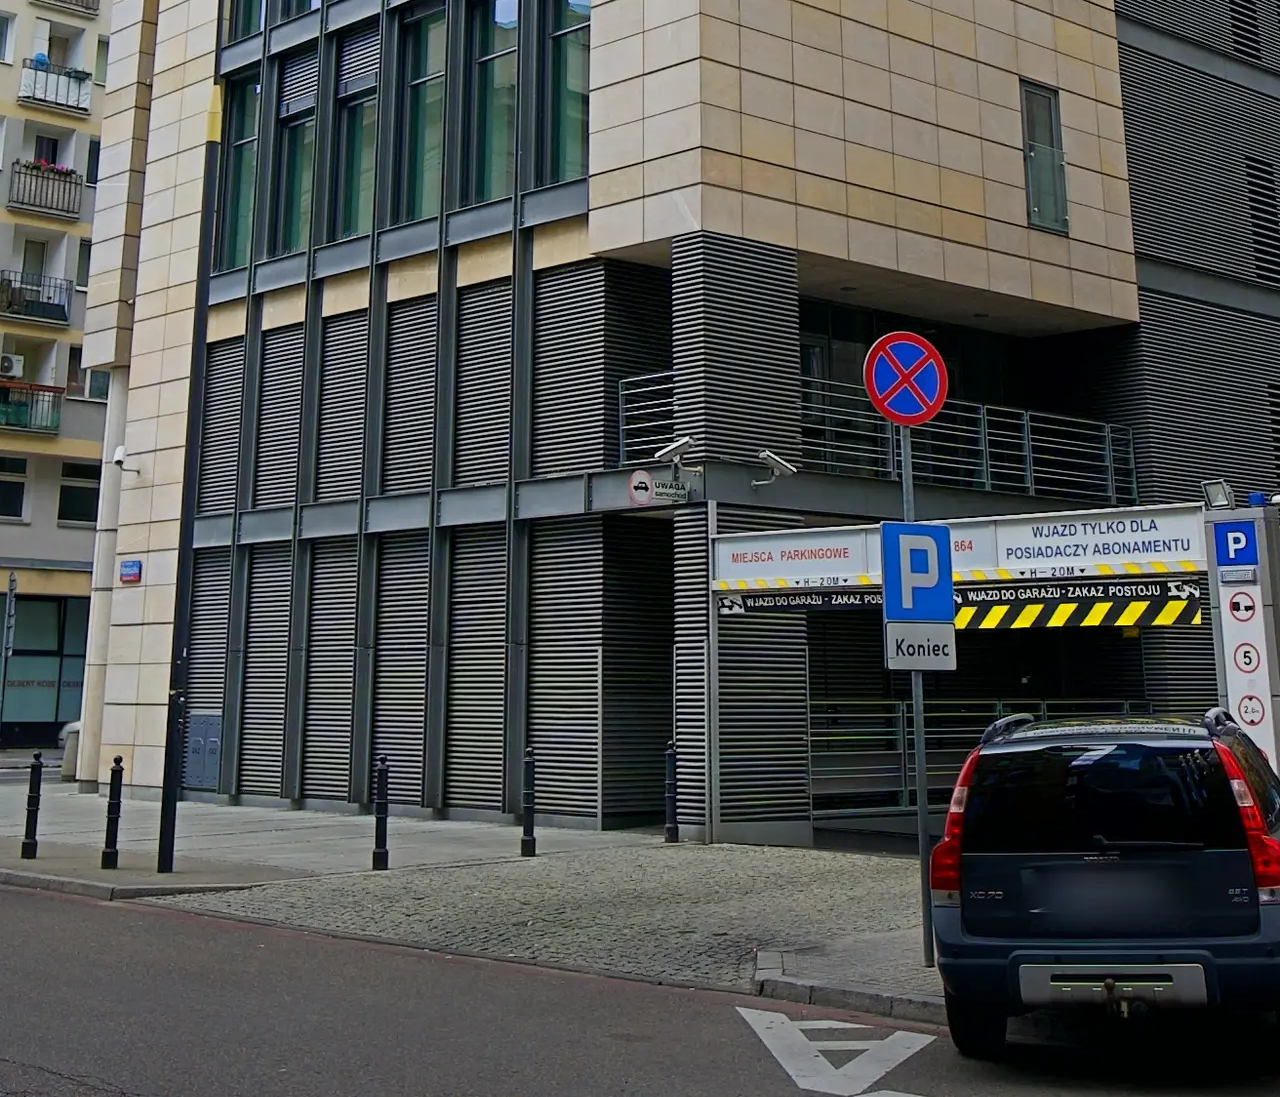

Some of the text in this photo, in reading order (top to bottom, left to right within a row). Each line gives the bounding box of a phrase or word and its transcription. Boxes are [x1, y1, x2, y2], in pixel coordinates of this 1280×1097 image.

[1031, 519, 1158, 539] WJAZD TYLKO DLA
[953, 539, 973, 552] 864
[1006, 538, 1190, 560] POSIADACZY ABONAMENTU
[1227, 532, 1247, 559] P
[731, 547, 850, 564] MIEJSCA PARKINGOWE
[898, 534, 939, 609] P
[745, 596, 775, 608] WJAZD
[775, 596, 787, 606] DO
[831, 594, 862, 605] ZAKAZ
[864, 594, 883, 604] POS
[967, 588, 1000, 601] WJAZD
[1001, 588, 1016, 600] DO
[1017, 584, 1061, 599] GARAŻU
[1067, 585, 1105, 598] ZAKAZ
[1108, 584, 1161, 597] POSTOJU
[894, 638, 950, 657] Koniec
[1243, 650, 1252, 666] 5
